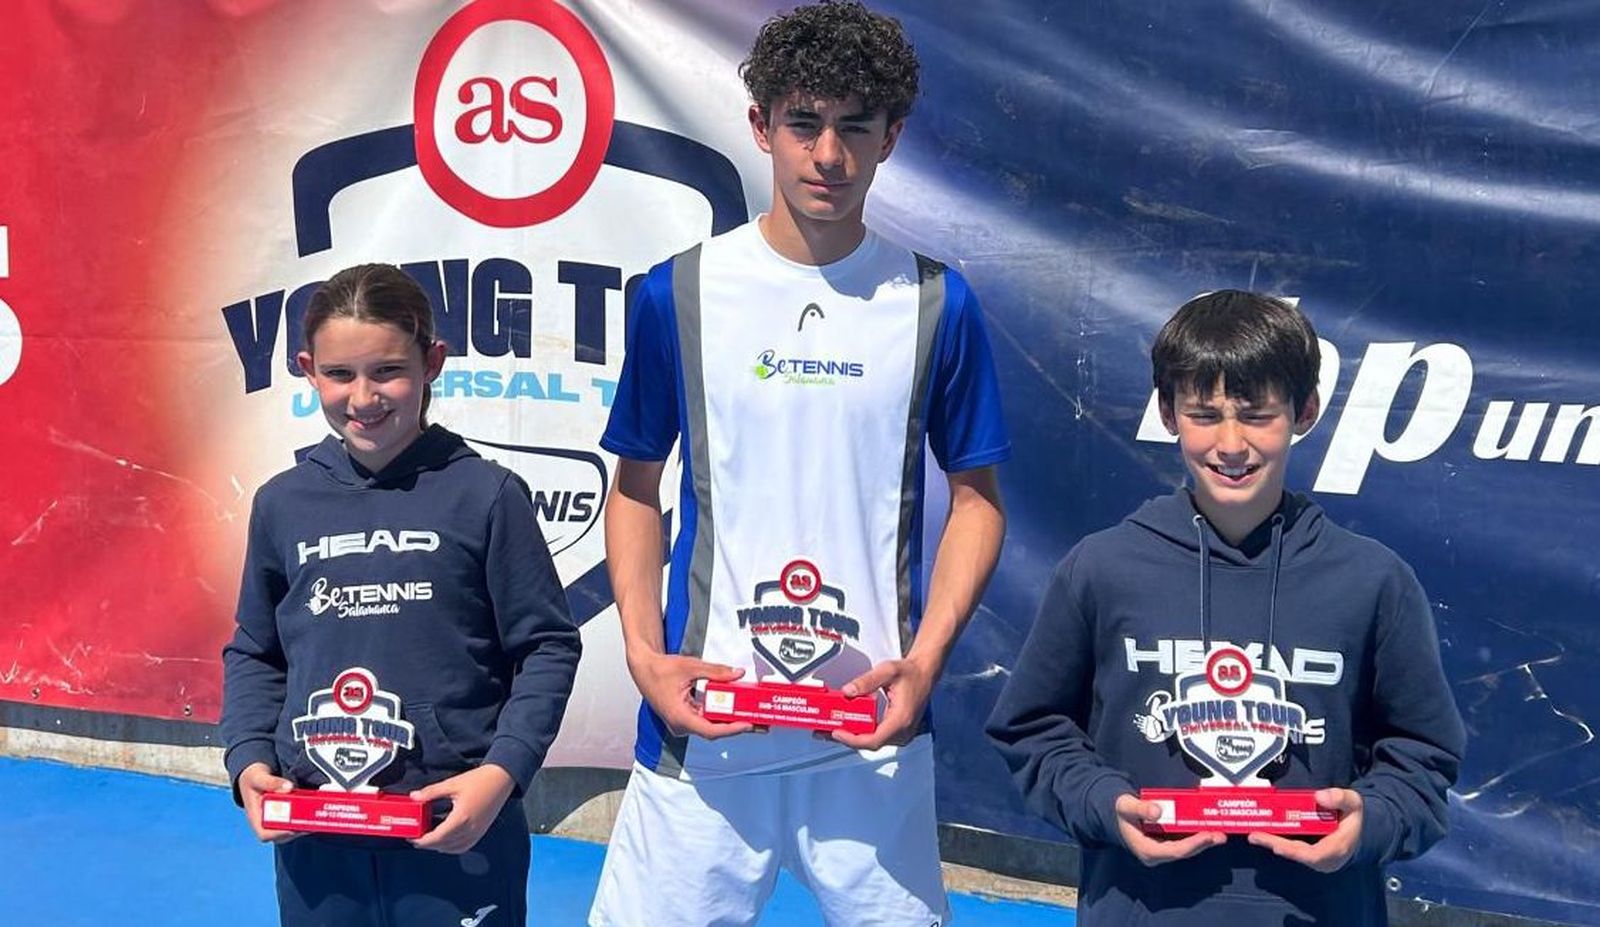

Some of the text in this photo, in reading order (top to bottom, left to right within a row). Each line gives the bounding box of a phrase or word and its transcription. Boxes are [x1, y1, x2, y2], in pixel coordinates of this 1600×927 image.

[455, 76, 563, 144] as
[222, 257, 533, 394] YNG
[298, 530, 440, 565] HEAD
[338, 601, 401, 619] Salamanca
[737, 606, 860, 640] YOUNG TOUR
[1124, 637, 1344, 686] HEAD
[295, 717, 410, 746] YOUNG TOUR
[1163, 700, 1237, 731] YOUNG
[1242, 701, 1303, 731] TOUR
